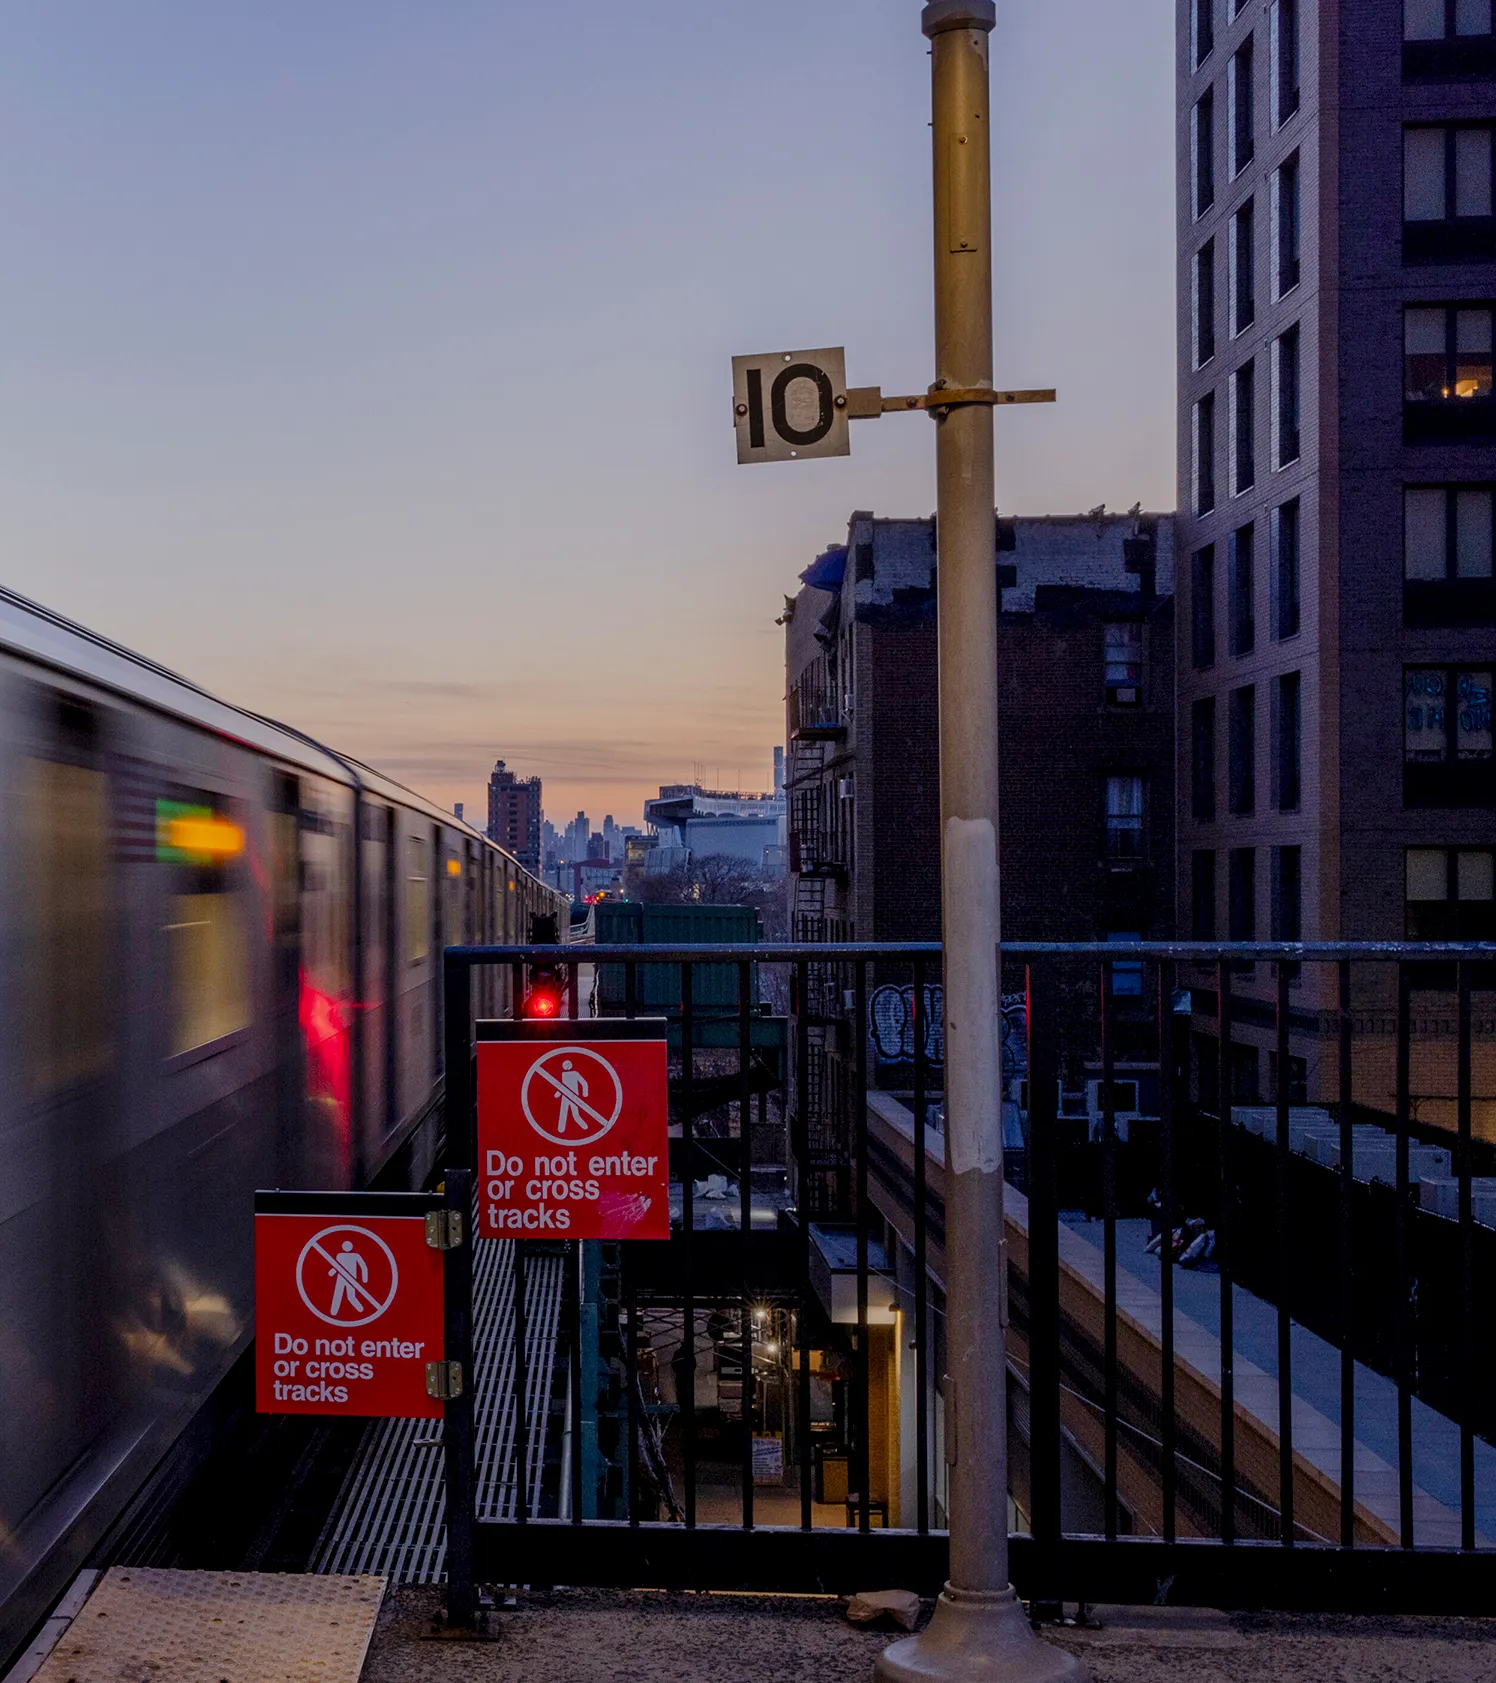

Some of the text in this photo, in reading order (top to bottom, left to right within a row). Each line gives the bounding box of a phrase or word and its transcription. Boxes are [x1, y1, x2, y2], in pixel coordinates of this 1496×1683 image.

[746, 362, 834, 448] 10
[486, 1149, 658, 1177] Do not enter
[487, 1179, 600, 1201] or cross
[487, 1202, 571, 1230] tracks
[274, 1332, 425, 1359] Do not enter
[273, 1360, 374, 1380] or cross
[273, 1380, 349, 1403] tracks
